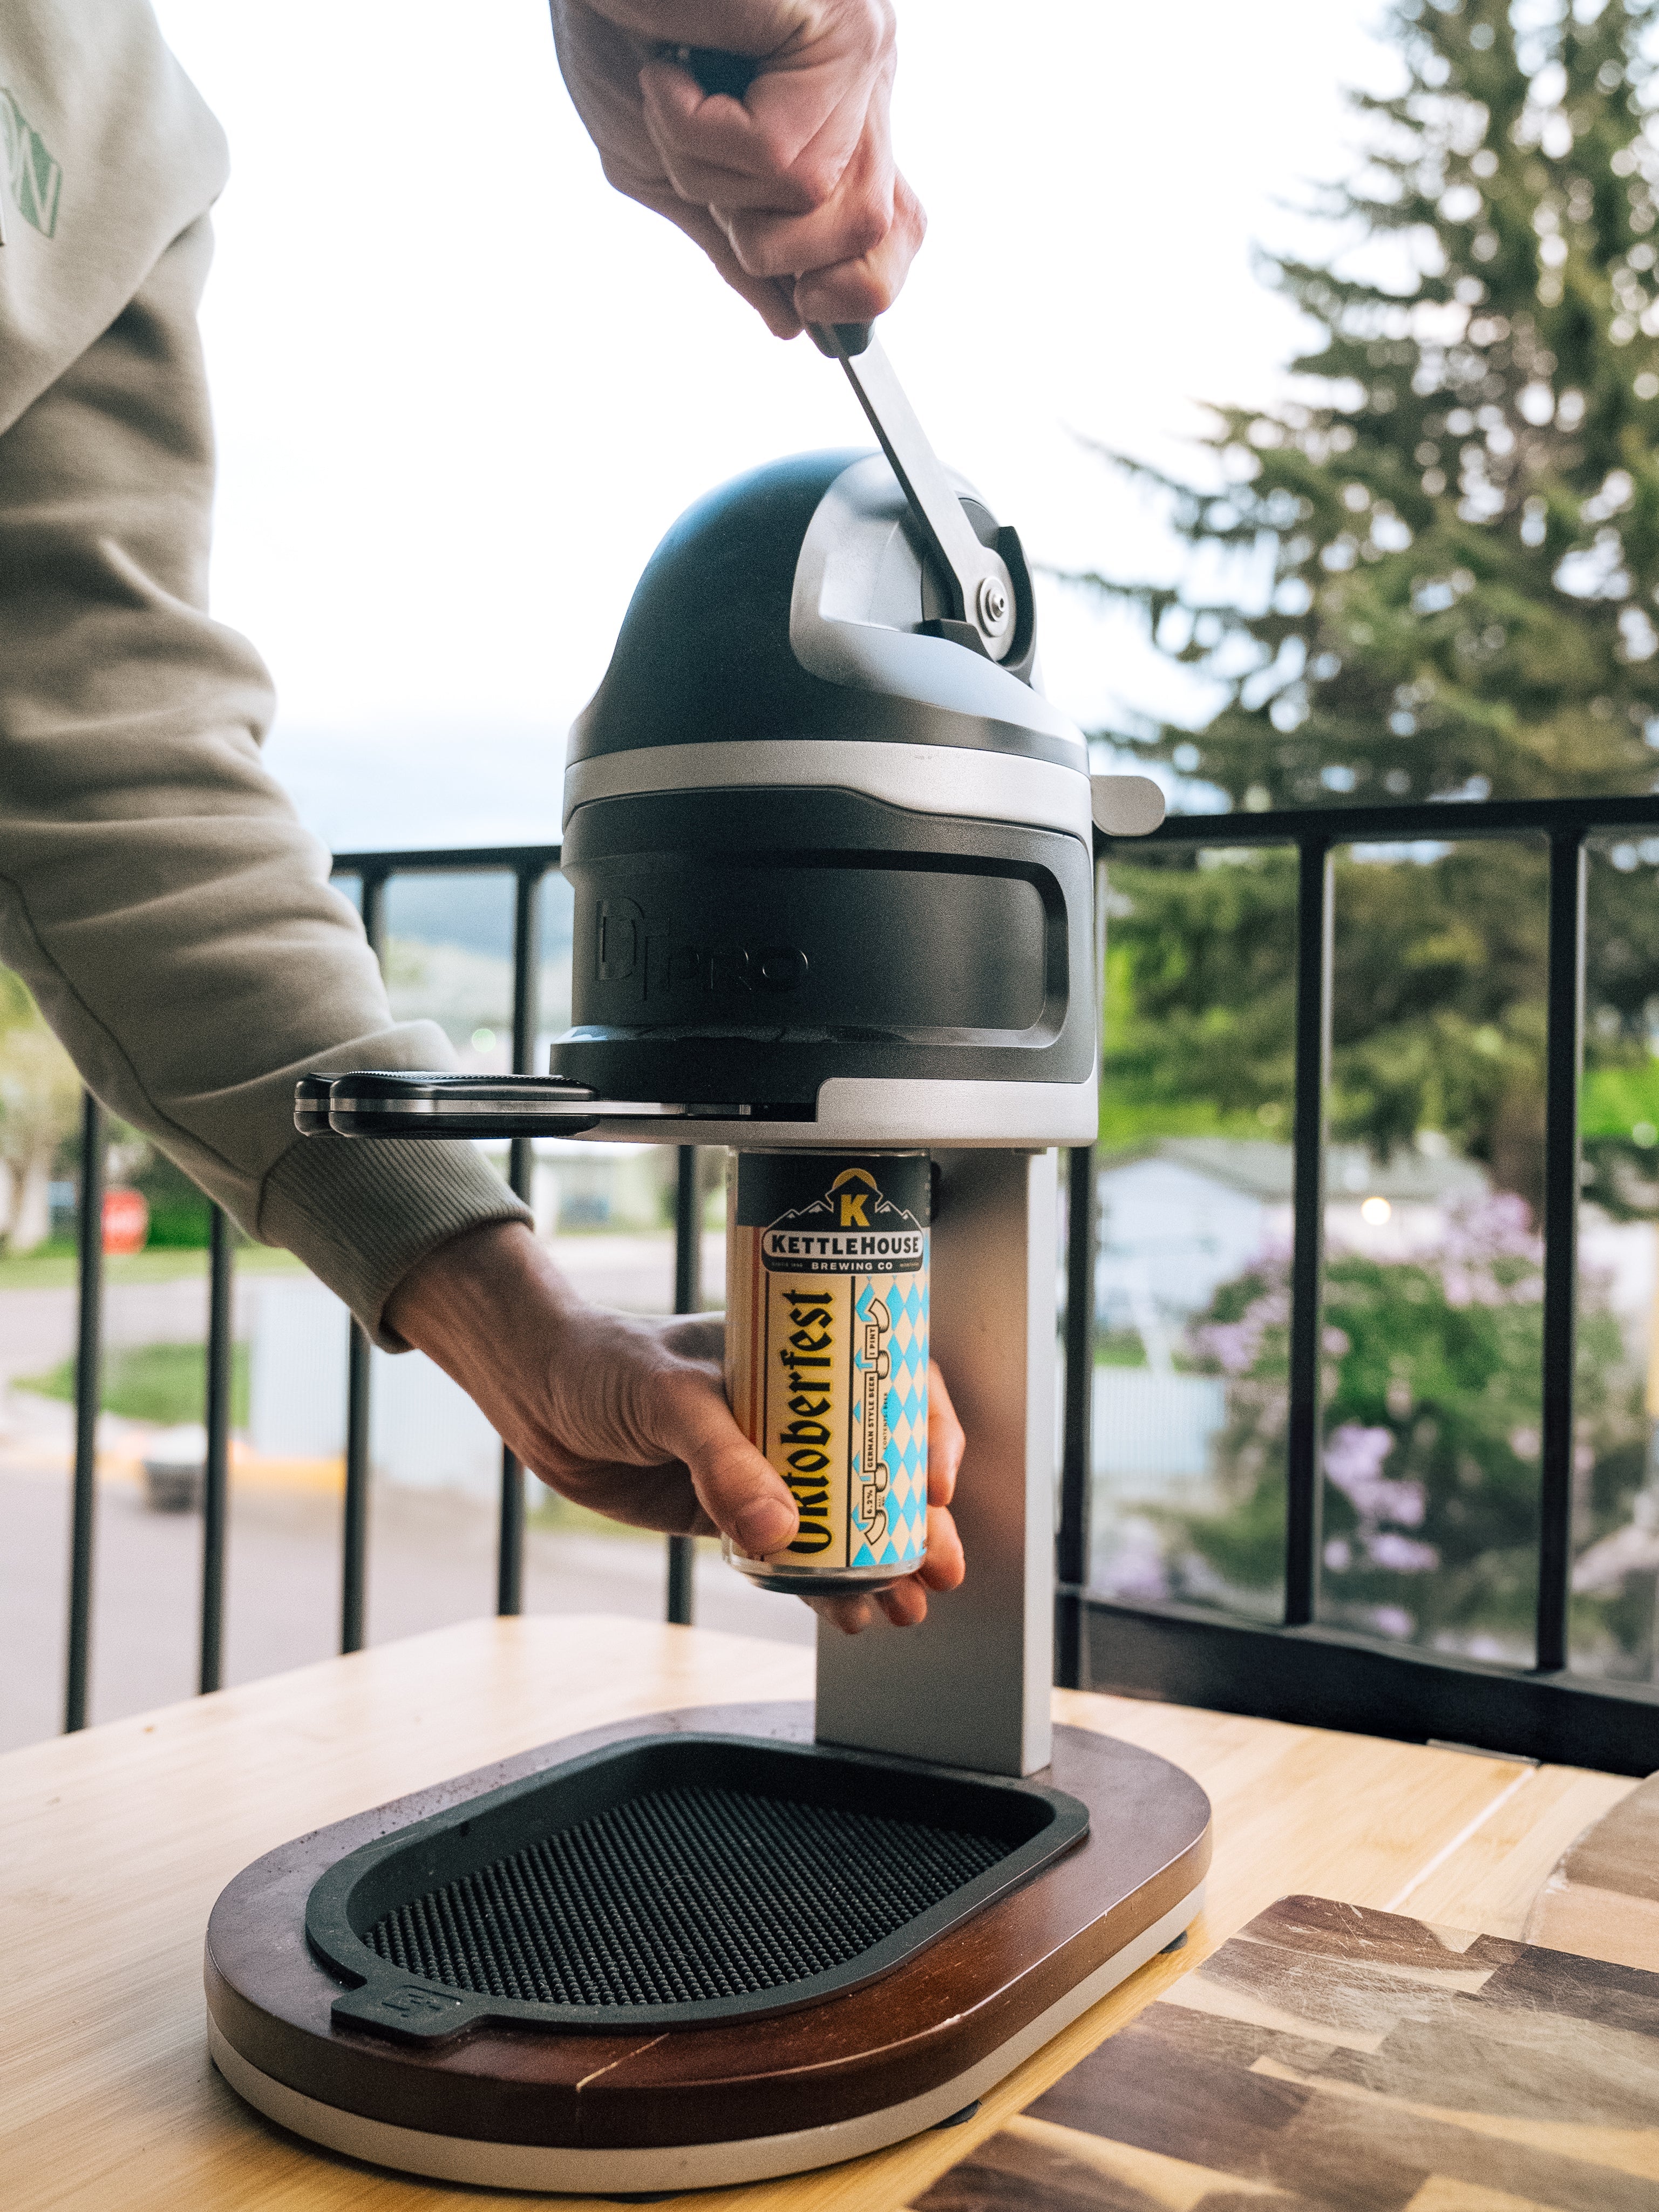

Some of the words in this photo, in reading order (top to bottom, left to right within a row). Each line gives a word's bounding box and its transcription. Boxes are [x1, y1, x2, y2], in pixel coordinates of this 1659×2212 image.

[840, 1194, 870, 1227] K
[772, 1235, 919, 1255] KETTLEHOUSE
[812, 1262, 872, 1270] BREWING
